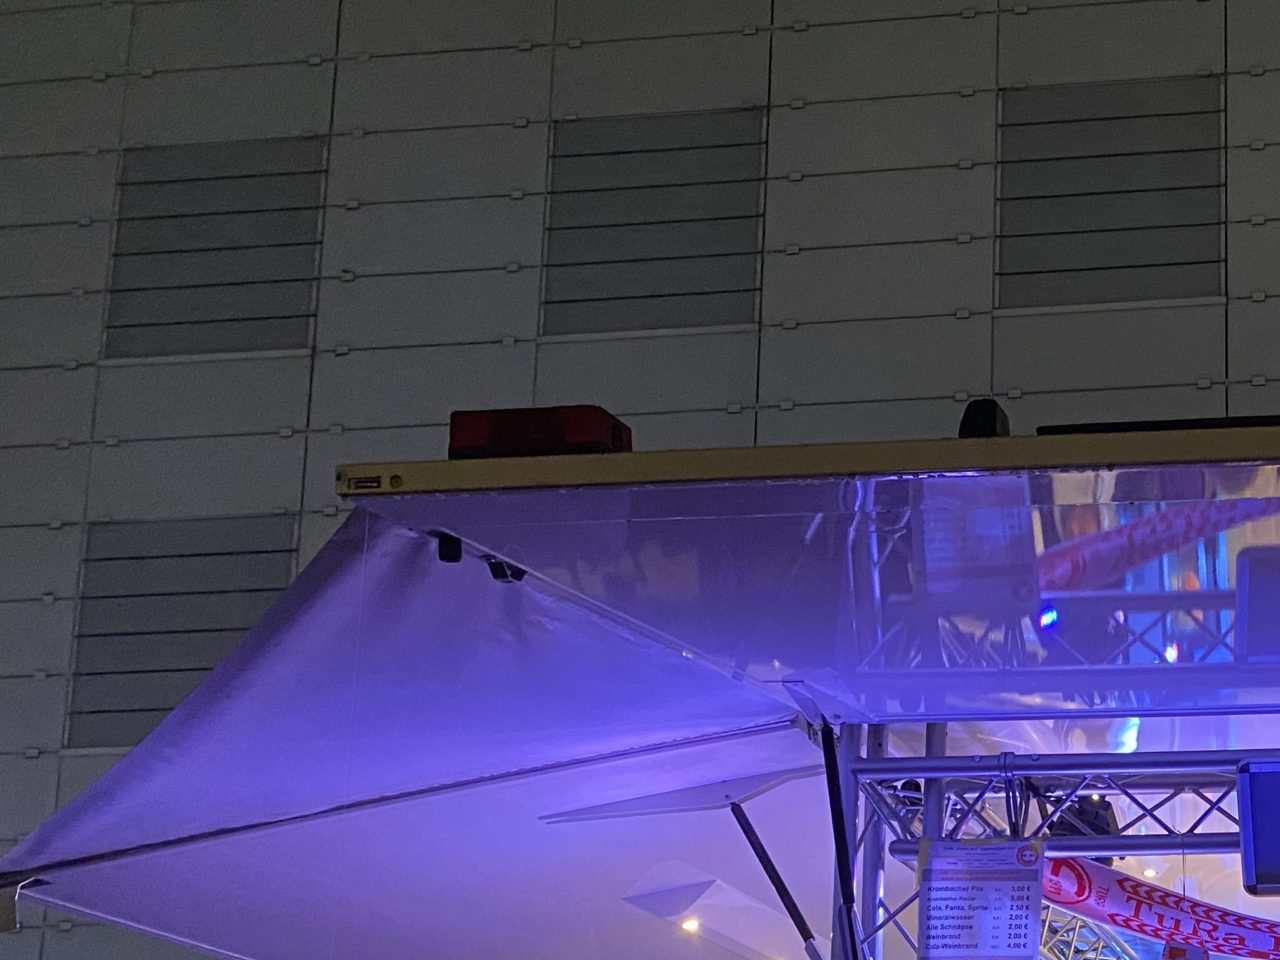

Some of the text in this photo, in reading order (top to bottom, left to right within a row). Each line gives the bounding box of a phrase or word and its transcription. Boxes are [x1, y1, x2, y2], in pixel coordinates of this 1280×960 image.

[1010, 885, 1025, 893] 3,00
[967, 904, 989, 912] Sprite
[1009, 904, 1024, 912] 2,50
[1125, 895, 1248, 948] TuRa
